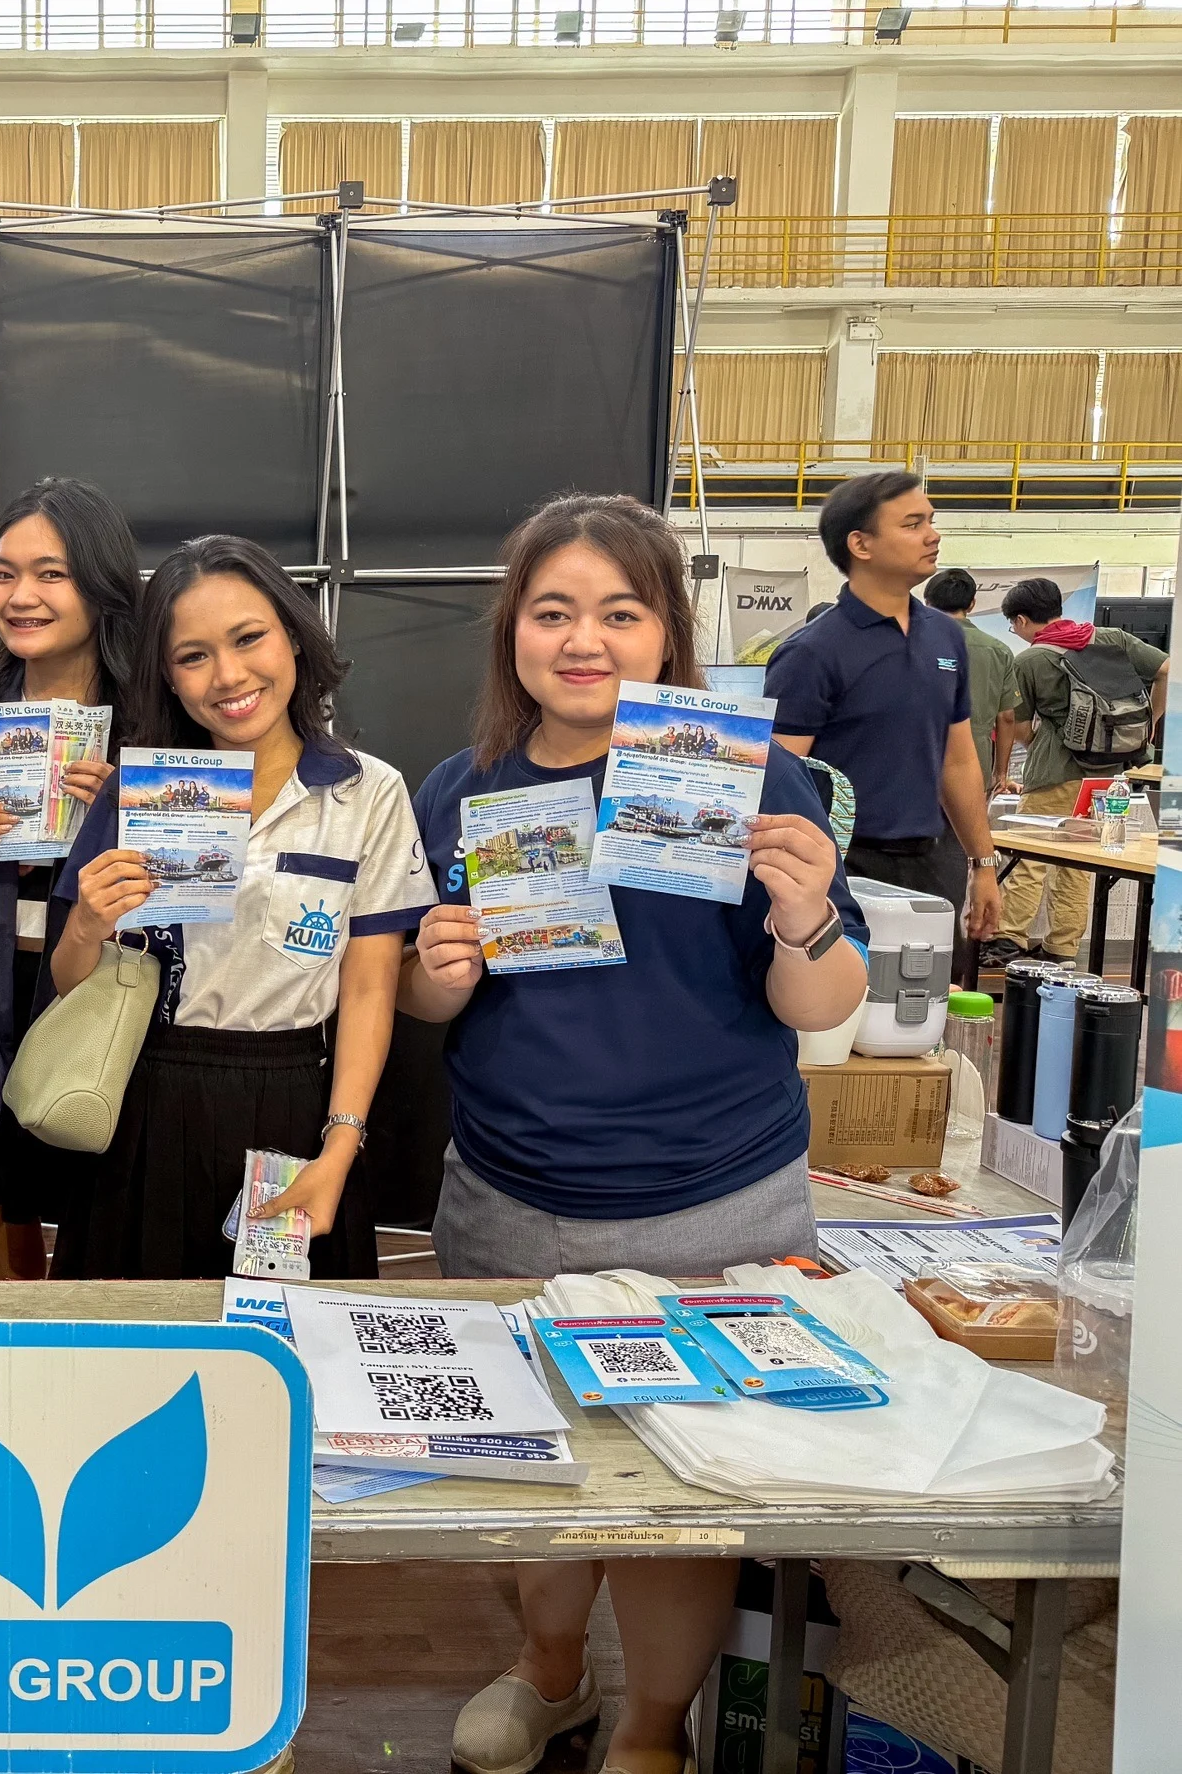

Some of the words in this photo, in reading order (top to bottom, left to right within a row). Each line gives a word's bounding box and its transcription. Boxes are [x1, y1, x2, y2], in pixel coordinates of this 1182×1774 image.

[754, 585, 775, 594] ISUZU
[674, 695, 698, 707] SVL
[701, 699, 738, 713] Group
[5, 707, 22, 715] SVL
[23, 706, 51, 717] Group
[168, 755, 189, 765] SVL
[192, 756, 222, 767] Group
[284, 926, 339, 950] KUMS
[236, 1297, 284, 1313] WE
[794, 1378, 842, 1387] FOLLOW
[808, 1390, 862, 1402] GROUP
[334, 1438, 374, 1446] BEST
[473, 1448, 524, 1458] PROJECT
[607, 1530, 664, 1540] พายสับปะรด
[9, 1658, 225, 1702] GROUP
